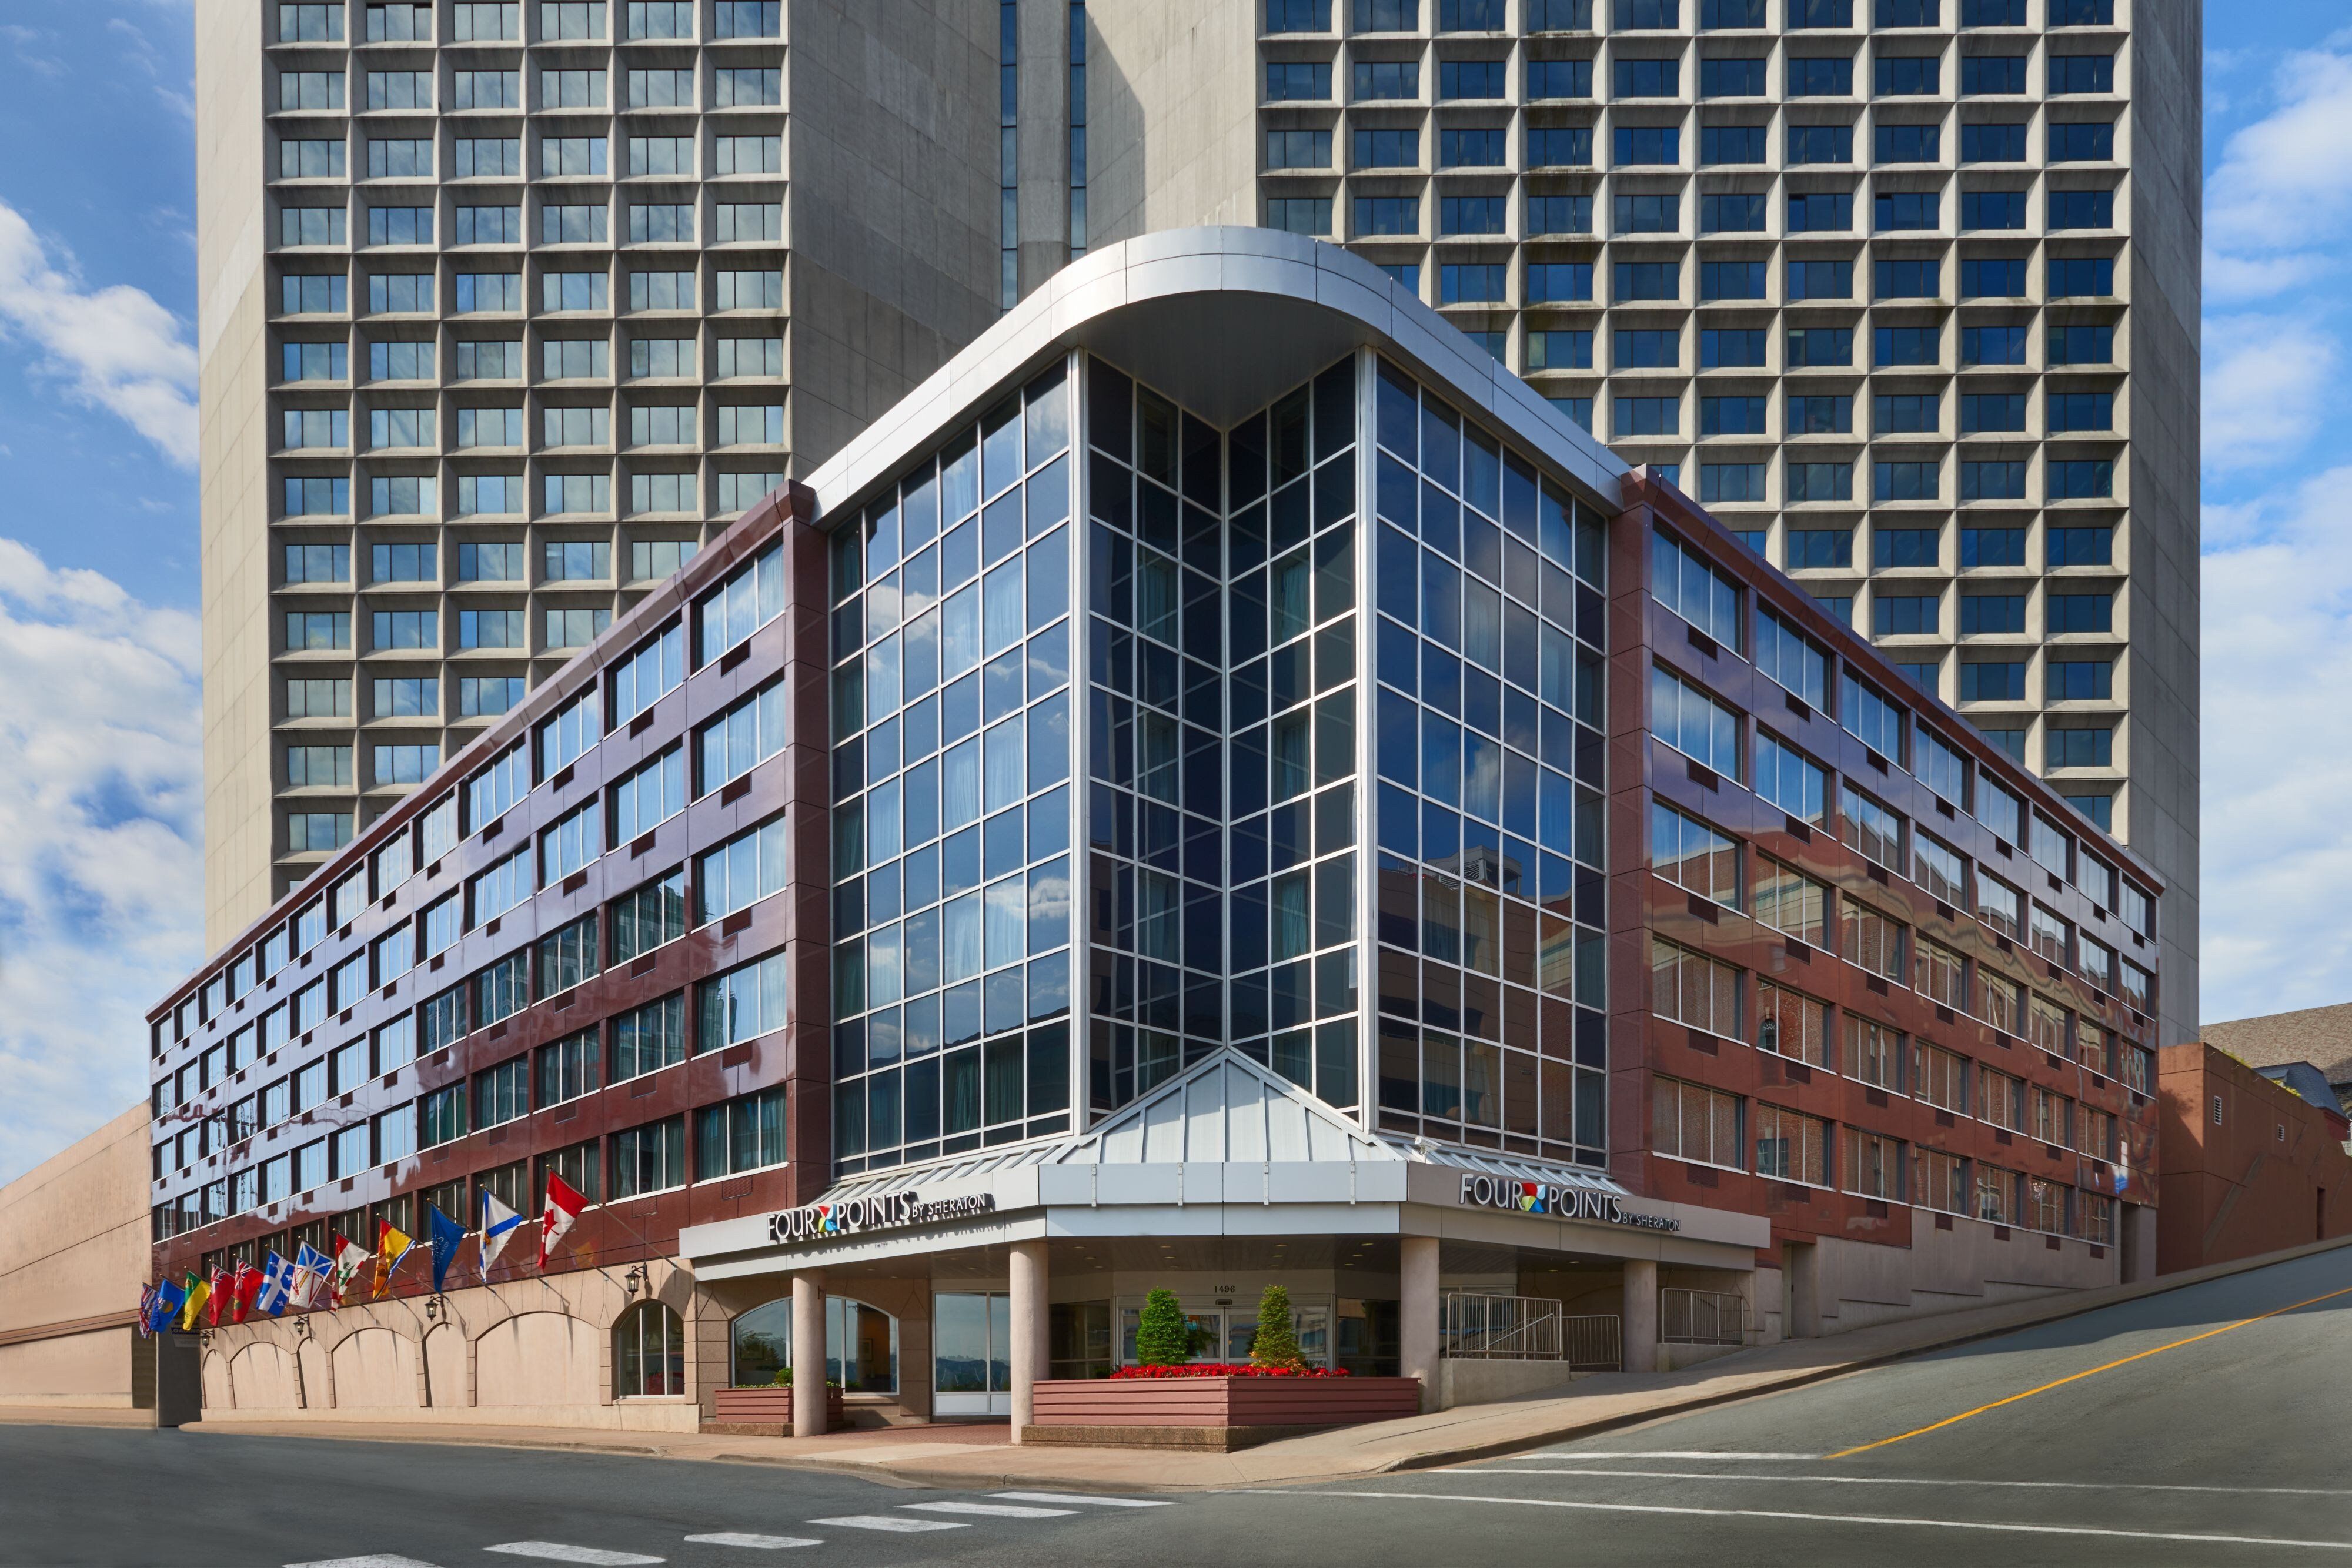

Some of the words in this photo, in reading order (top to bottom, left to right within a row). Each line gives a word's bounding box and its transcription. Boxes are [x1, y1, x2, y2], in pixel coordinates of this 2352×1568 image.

[767, 1208, 817, 1241] FOUR
[837, 1190, 911, 1229] POINTS
[912, 1203, 924, 1218] BY
[928, 1193, 985, 1215] SHERATON
[1460, 1173, 1524, 1211] FOUR
[1549, 1186, 1622, 1223] POINTS
[1623, 1212, 1633, 1224] BY
[1636, 1214, 1681, 1231] SHERATON
